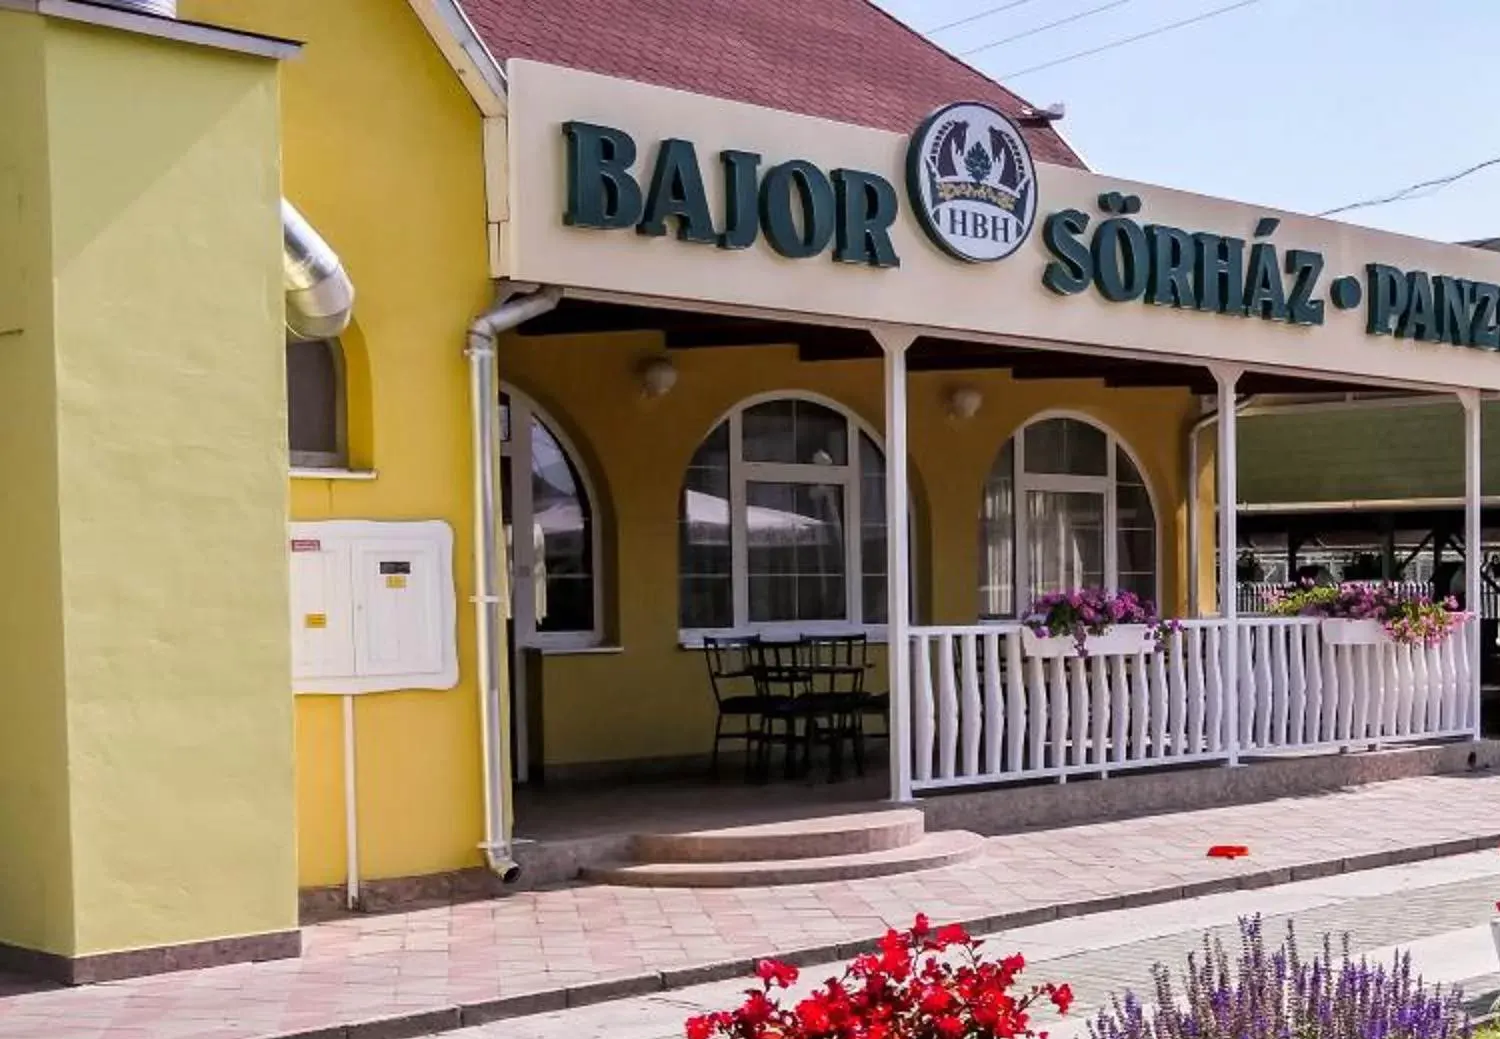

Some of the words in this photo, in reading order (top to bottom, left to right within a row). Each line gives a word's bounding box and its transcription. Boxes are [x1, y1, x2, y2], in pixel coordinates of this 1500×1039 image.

[562, 120, 899, 268] BAJOR
[1042, 191, 1325, 326] SÖRHÁZ
[949, 207, 1010, 243] HBH
